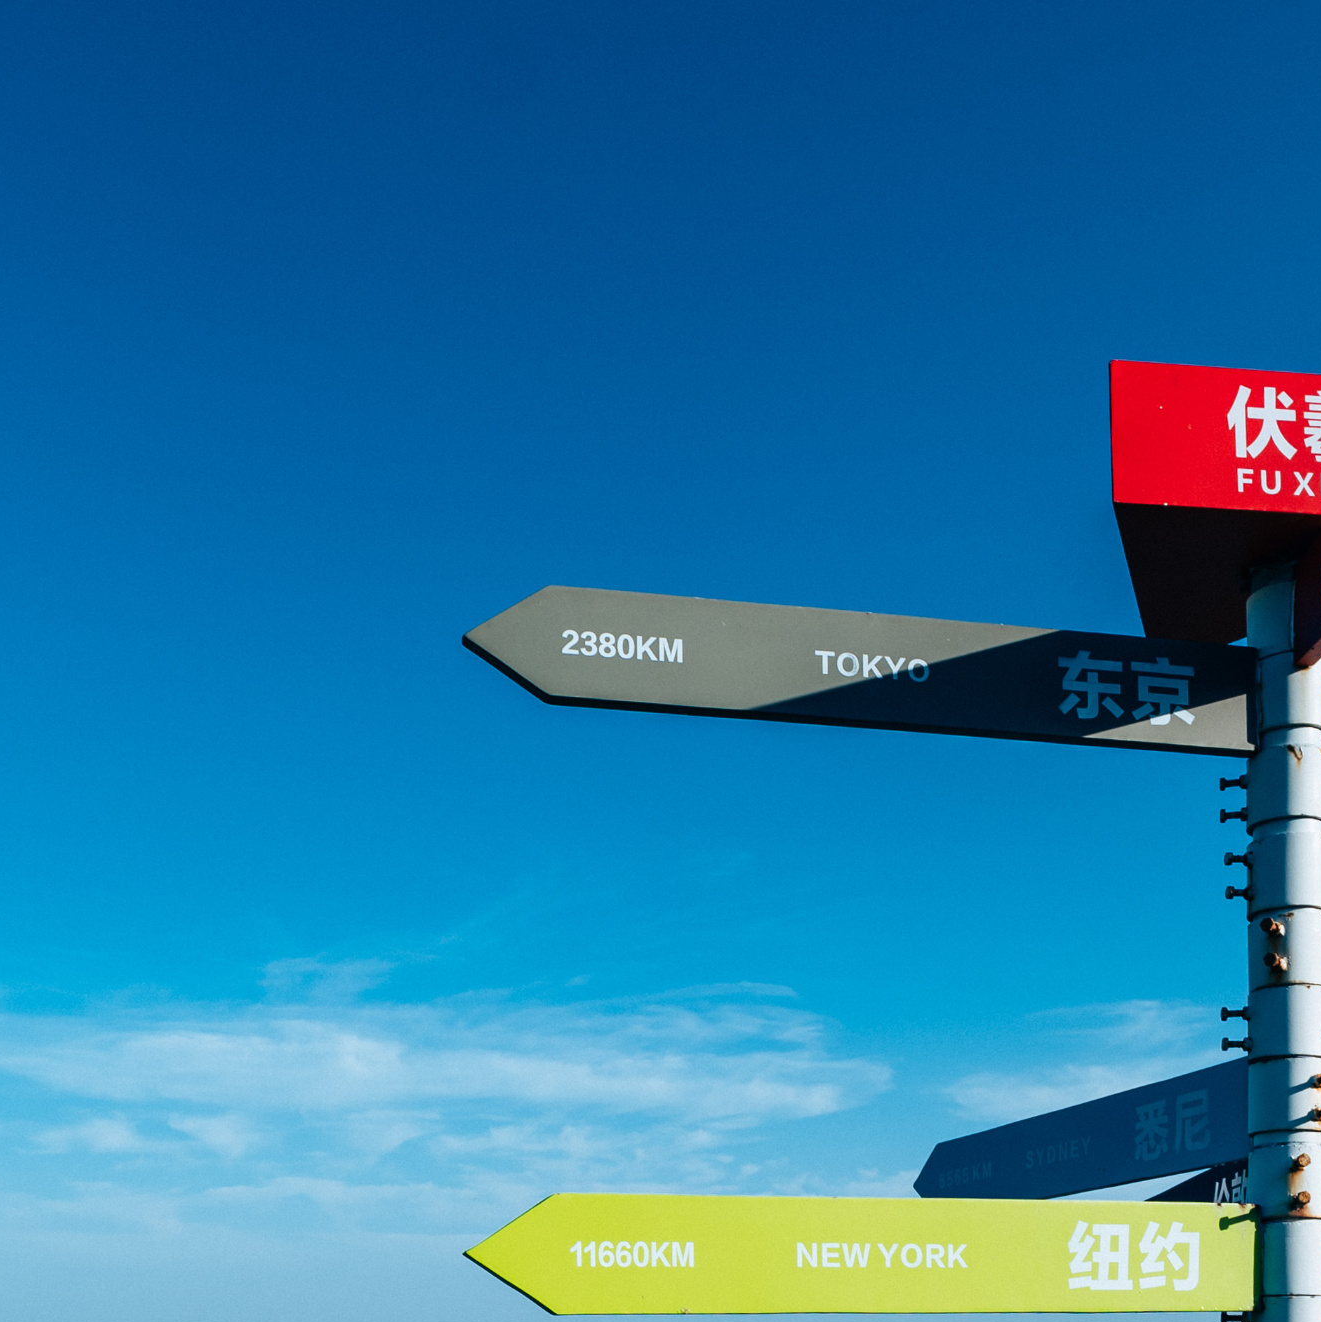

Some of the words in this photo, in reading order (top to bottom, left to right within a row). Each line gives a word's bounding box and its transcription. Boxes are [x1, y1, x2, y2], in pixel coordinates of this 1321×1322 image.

[561, 629, 684, 664] 2380KM
[814, 648, 930, 685] TOKYO
[1056, 649, 1197, 728] 东京
[1025, 1135, 1092, 1169] SYDNEY
[1134, 1088, 1211, 1162] 悉尼
[569, 1240, 696, 1269] 11660KM
[796, 1242, 873, 1269] NEW
[877, 1242, 969, 1269] YORK
[1067, 1220, 1201, 1292] 纽约
